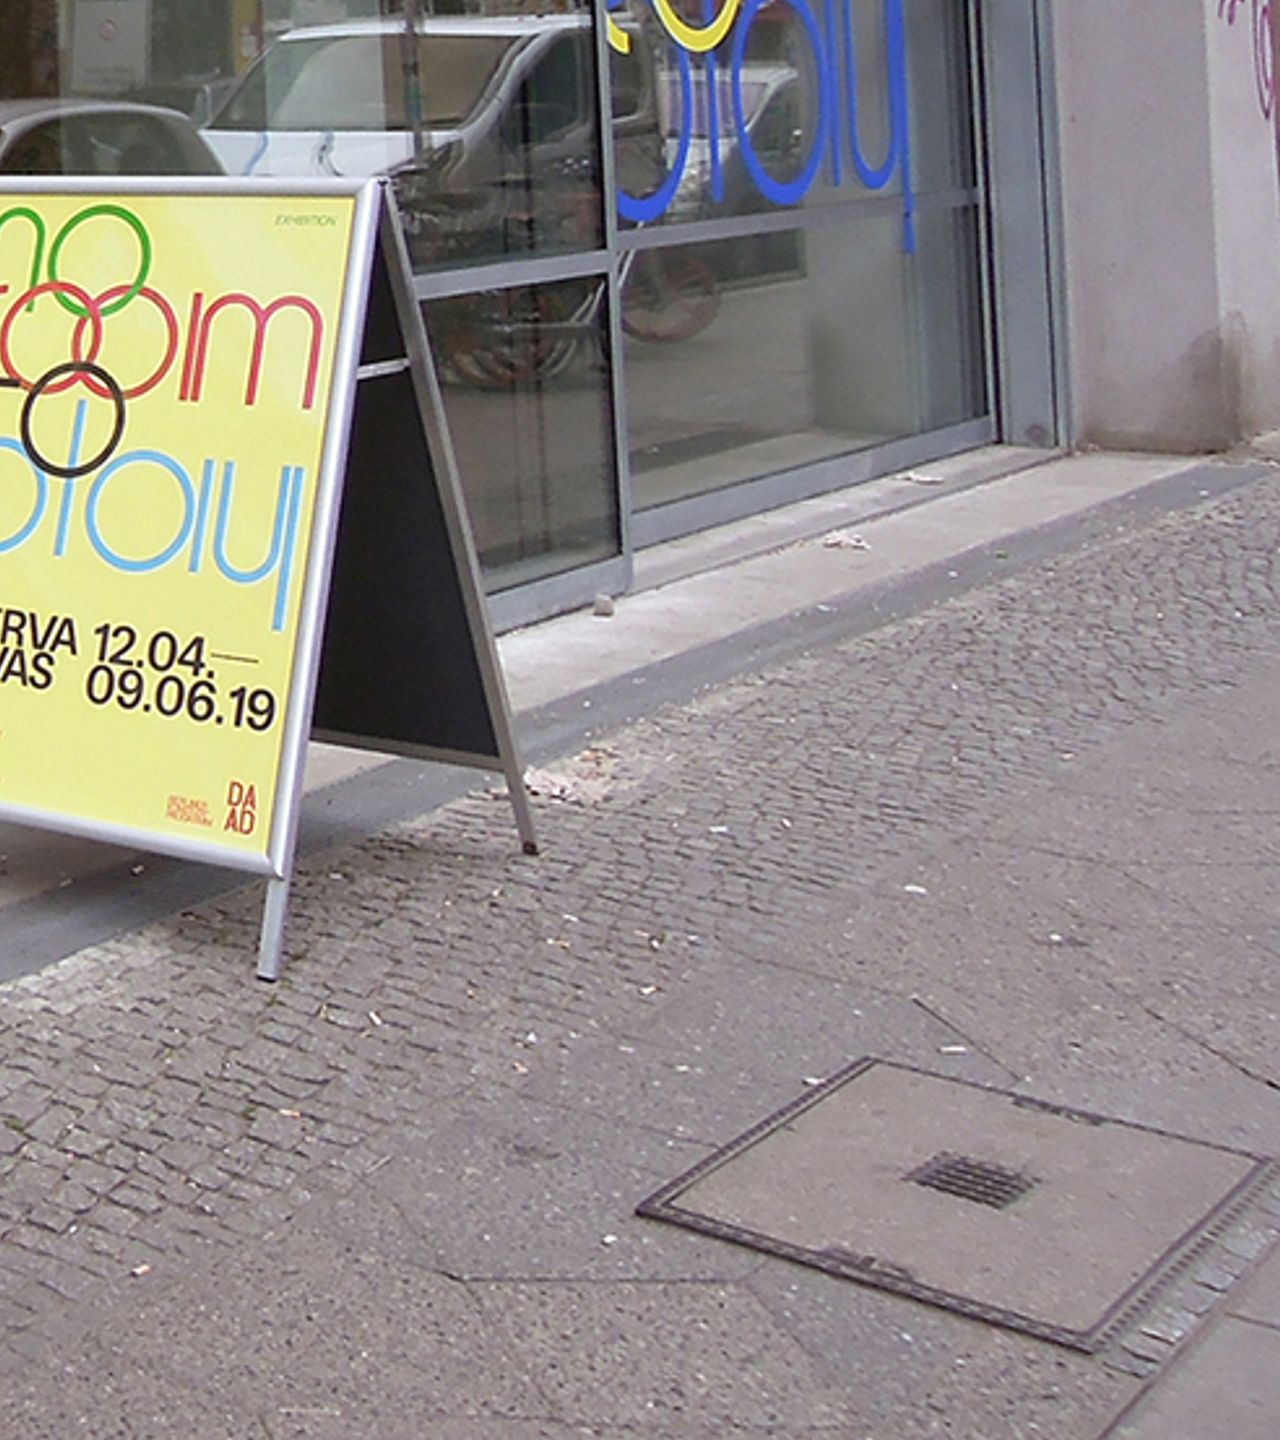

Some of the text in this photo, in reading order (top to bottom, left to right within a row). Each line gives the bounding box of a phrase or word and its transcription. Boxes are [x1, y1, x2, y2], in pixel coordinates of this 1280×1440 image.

[86, 665, 277, 732] 09.06.19
[228, 780, 257, 811] DA
[224, 808, 256, 836] AD
